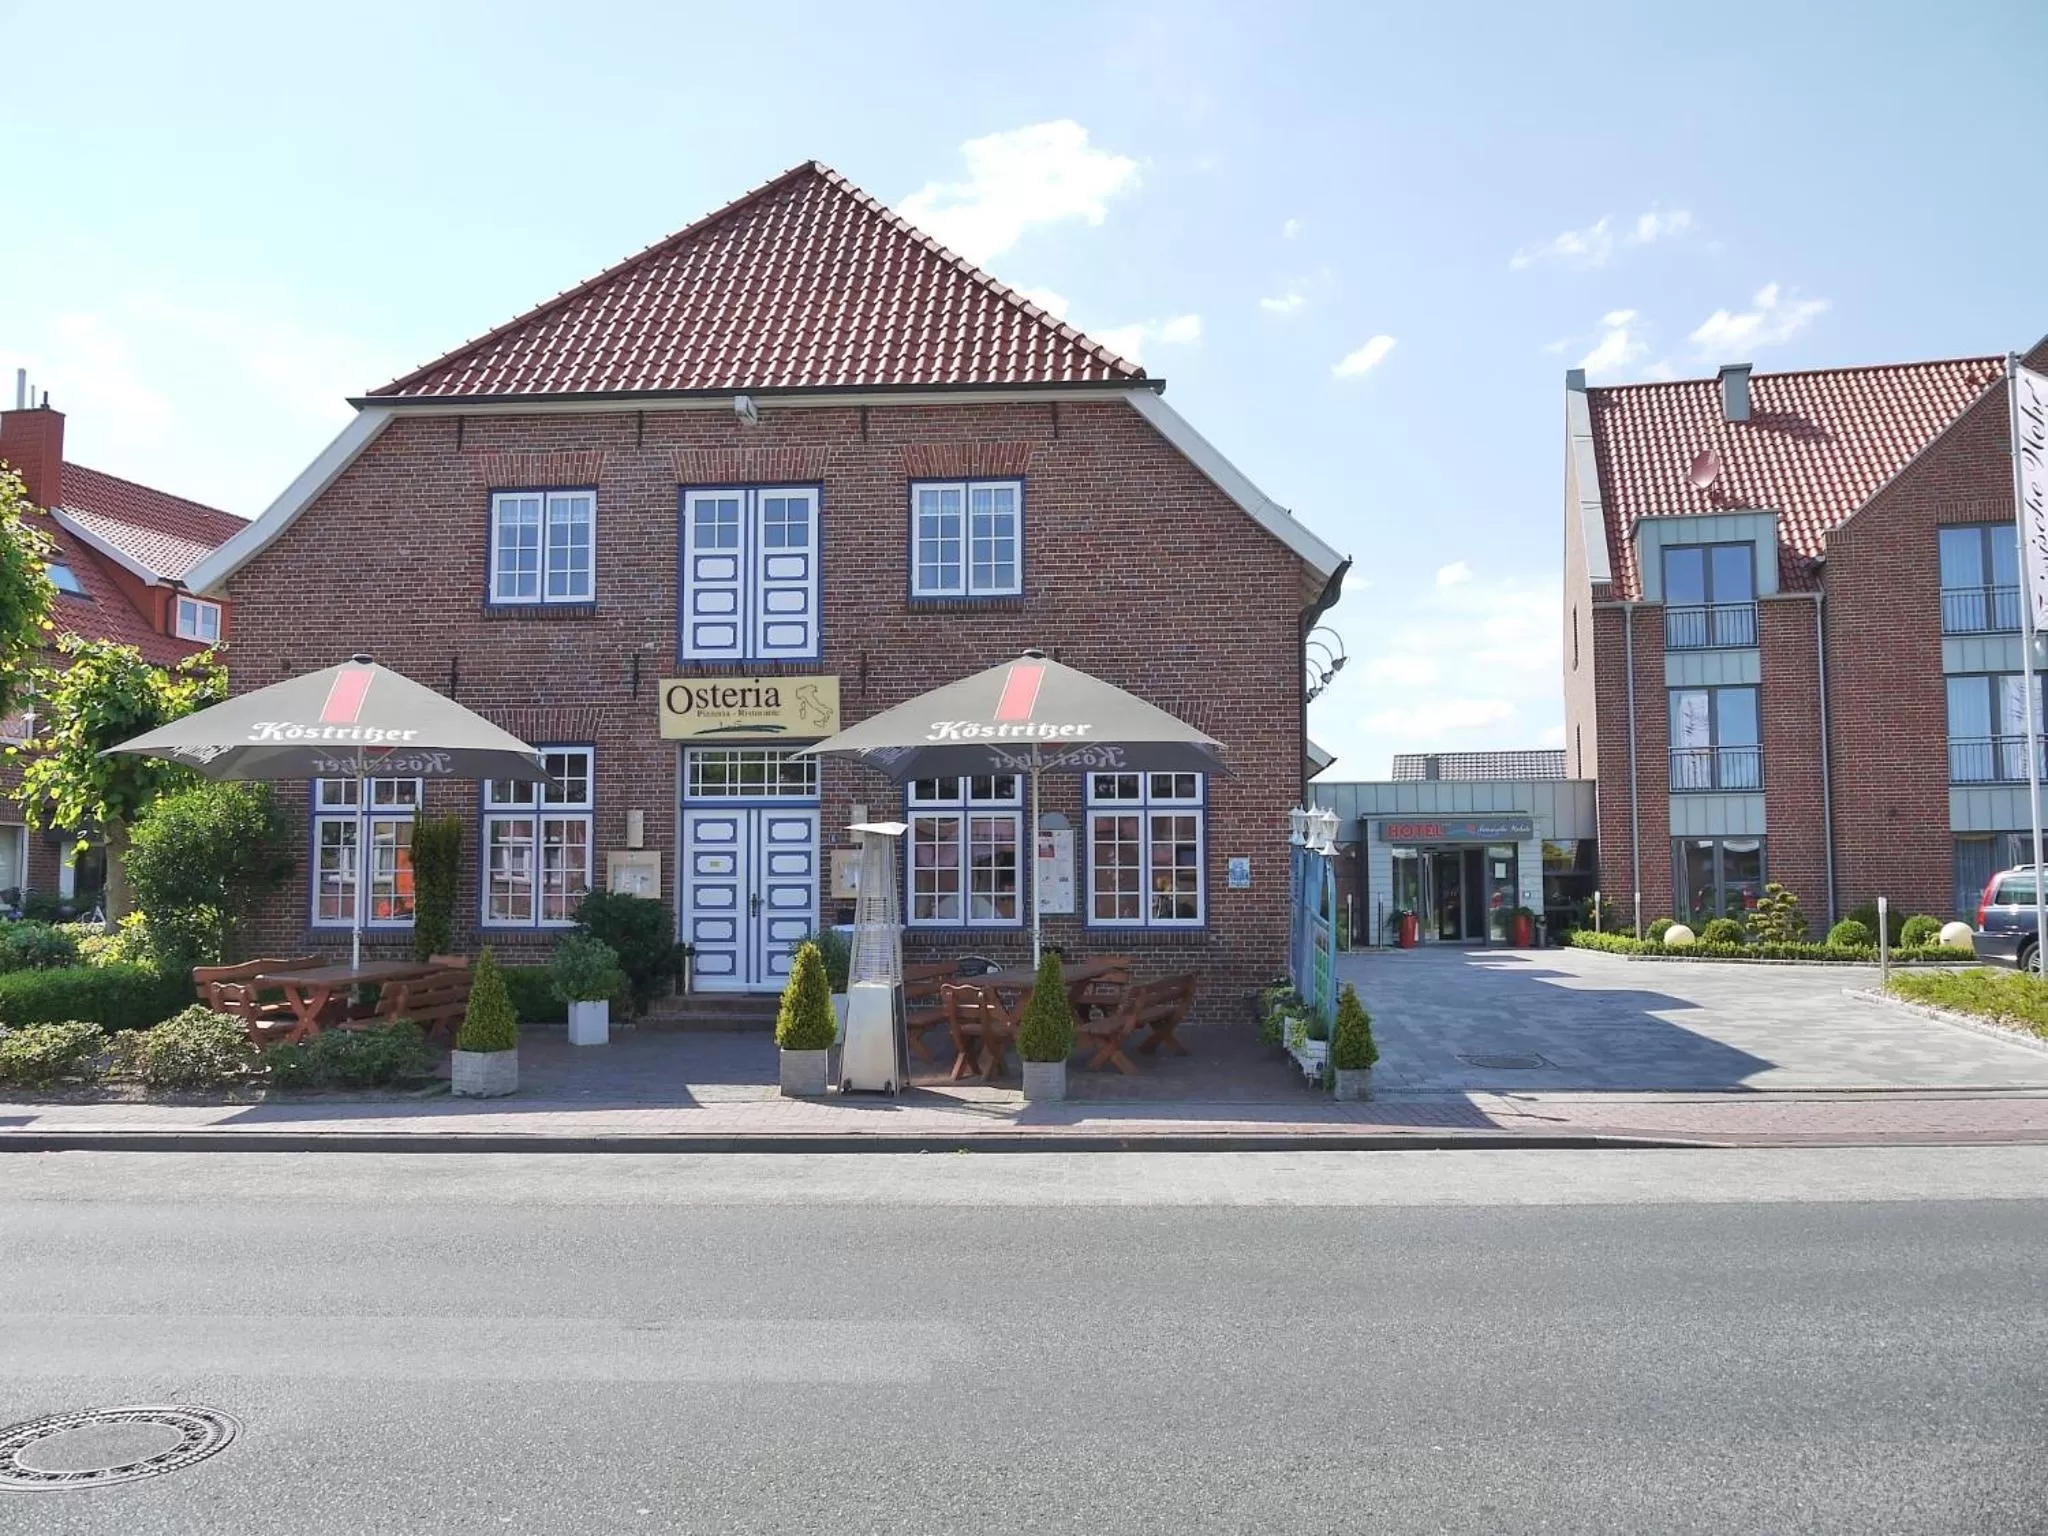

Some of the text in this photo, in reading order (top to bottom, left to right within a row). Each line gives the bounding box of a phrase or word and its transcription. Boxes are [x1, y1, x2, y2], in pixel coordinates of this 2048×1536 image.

[666, 679, 782, 715] Osteria
[247, 720, 420, 742] Köstritzer
[925, 720, 1092, 741] Köstritzer
[1387, 823, 1442, 840] HOTEL
